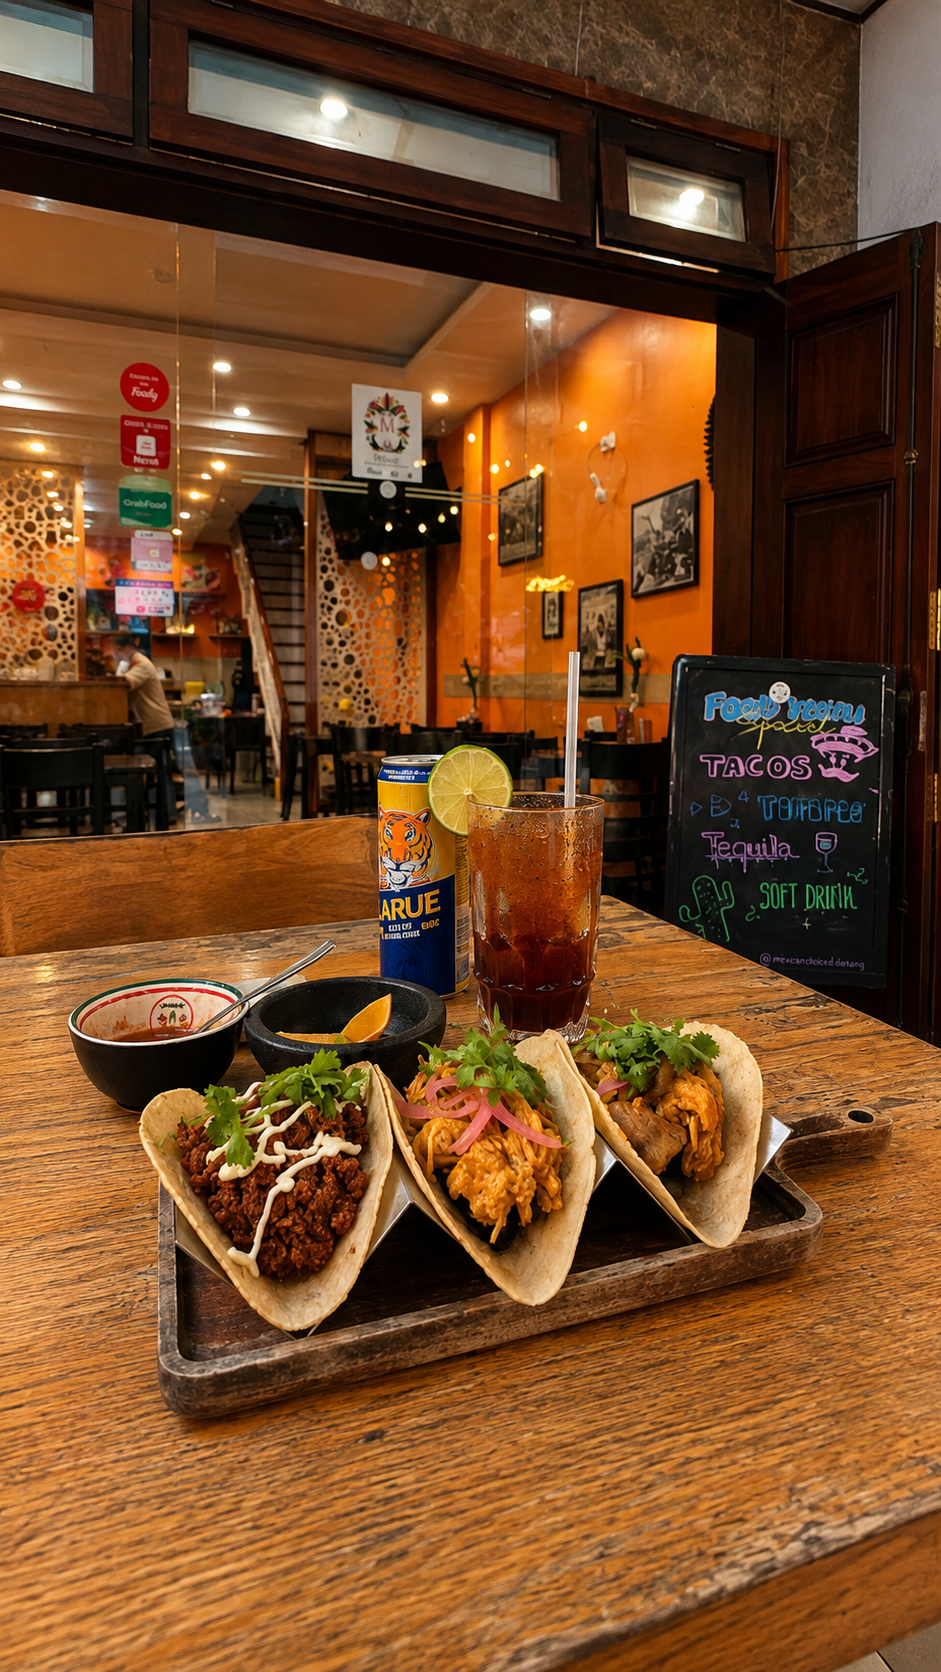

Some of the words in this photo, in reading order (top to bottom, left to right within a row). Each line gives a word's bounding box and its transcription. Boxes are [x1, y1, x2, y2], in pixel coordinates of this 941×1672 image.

[131, 386, 159, 403] Foody
[380, 417, 395, 433] M
[123, 499, 167, 510] GrabFood
[700, 754, 813, 780] TACOS
[701, 831, 800, 873] Tequila
[380, 889, 441, 921] ARUE
[760, 882, 798, 910] SOFT
